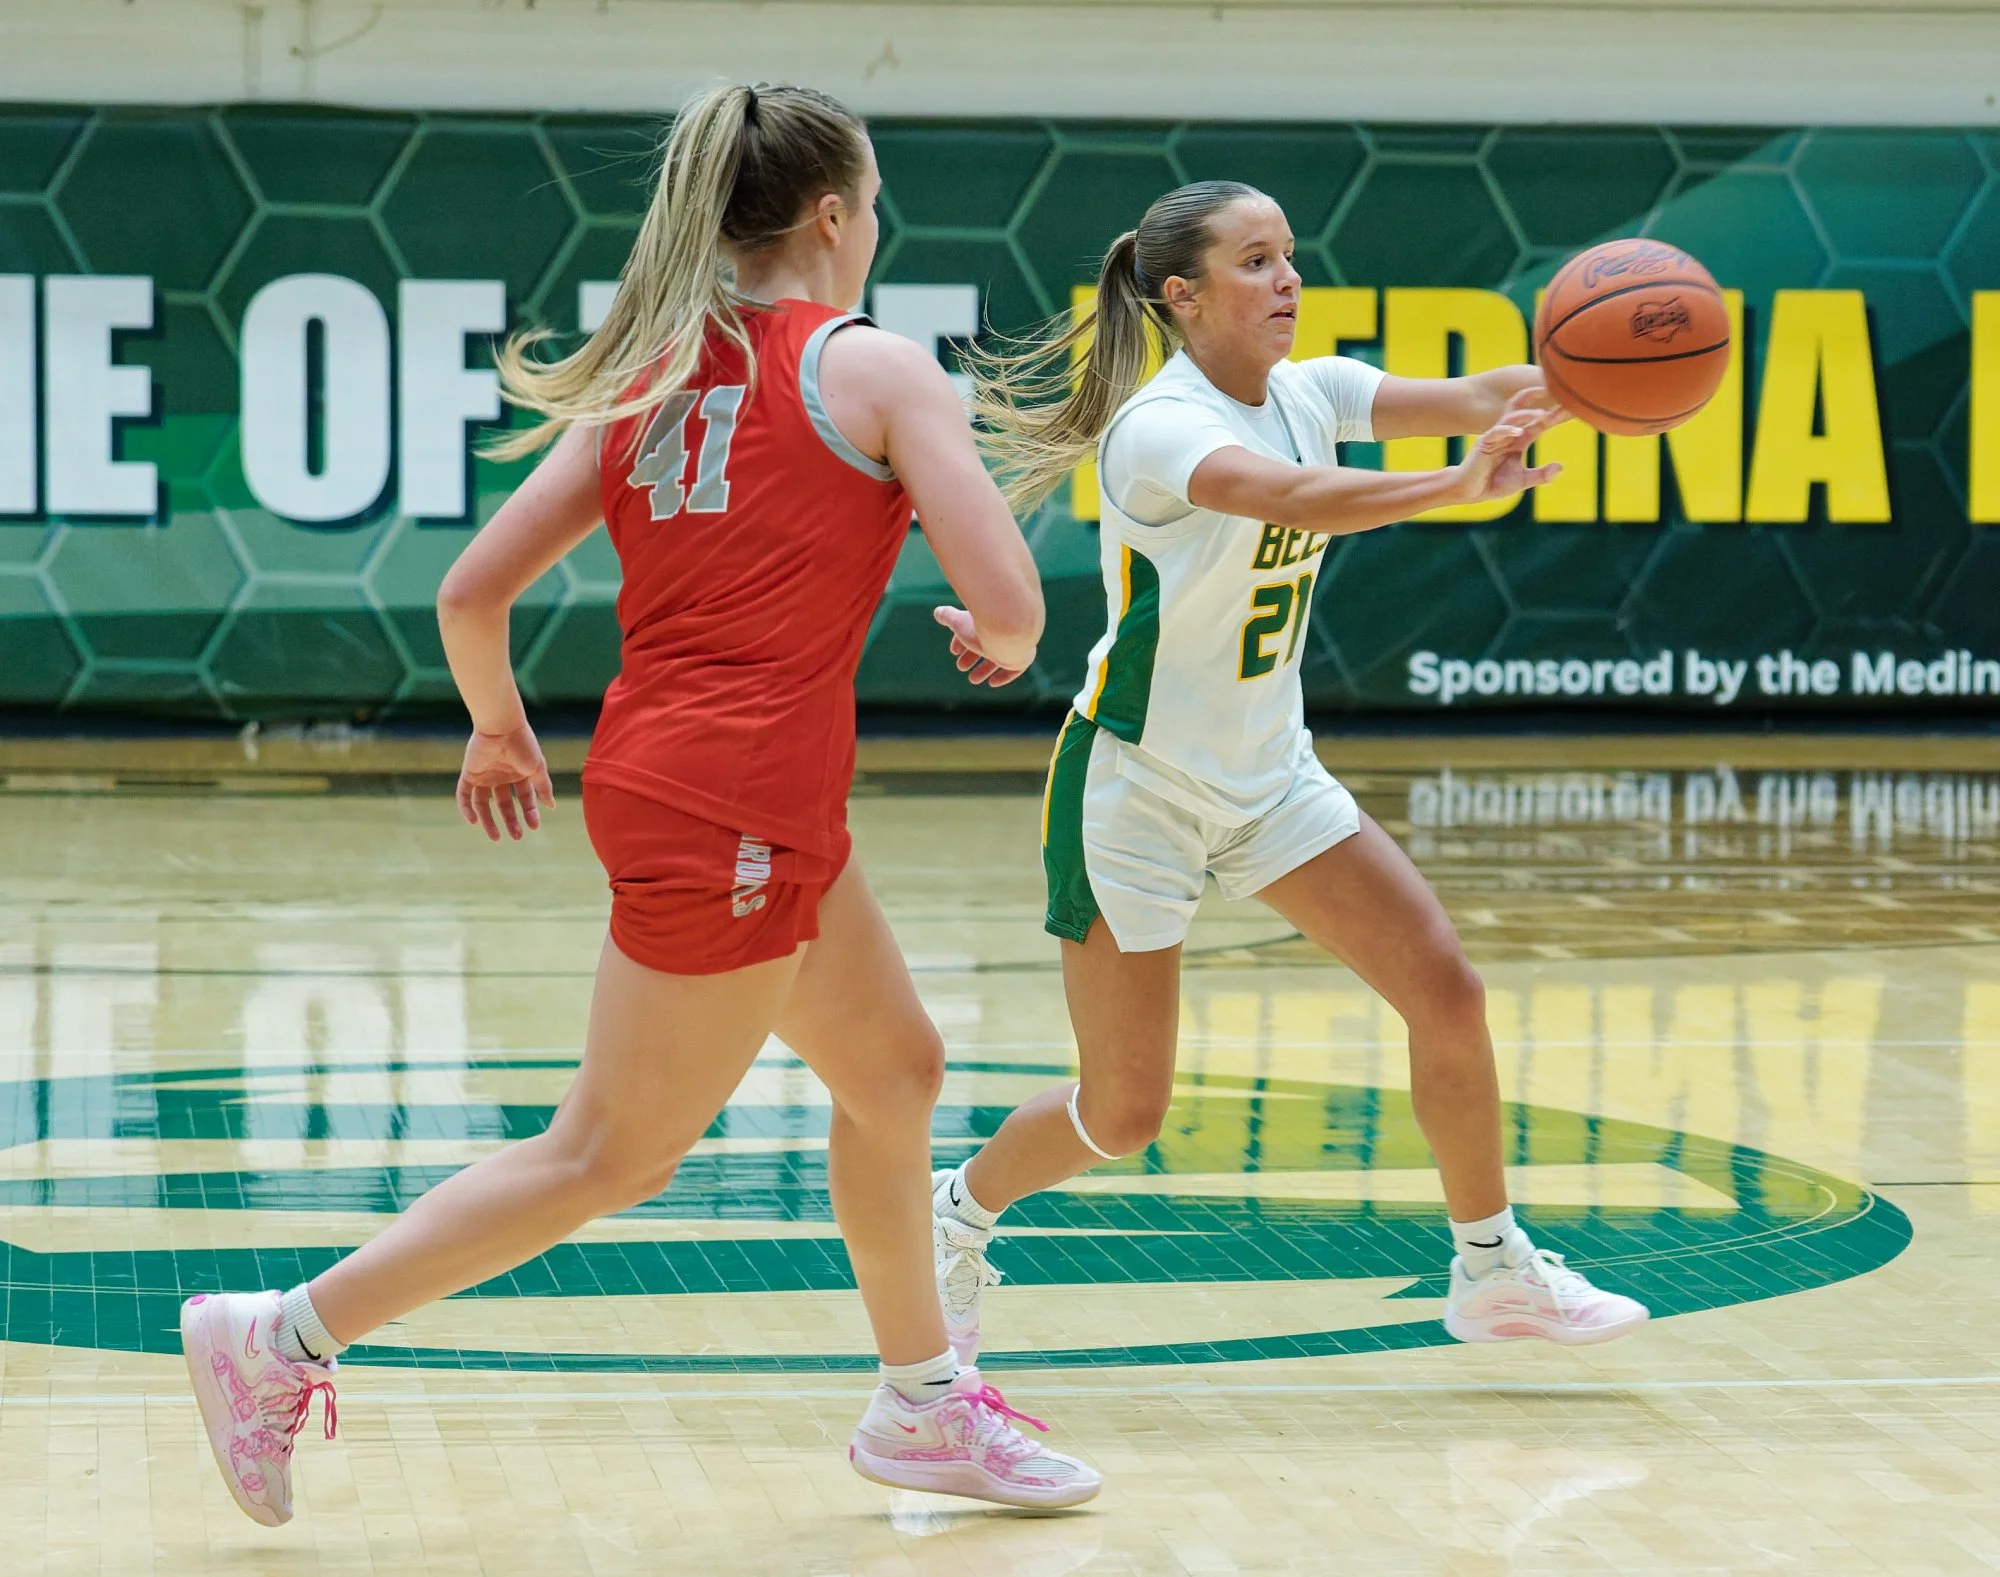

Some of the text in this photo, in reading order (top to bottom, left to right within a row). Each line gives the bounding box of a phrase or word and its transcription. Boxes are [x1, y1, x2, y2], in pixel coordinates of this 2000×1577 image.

[240, 272, 507, 522] OF
[627, 384, 747, 521] 41
[1237, 571, 1313, 682] 21
[1407, 649, 2000, 705] Sponsored by the Medin
